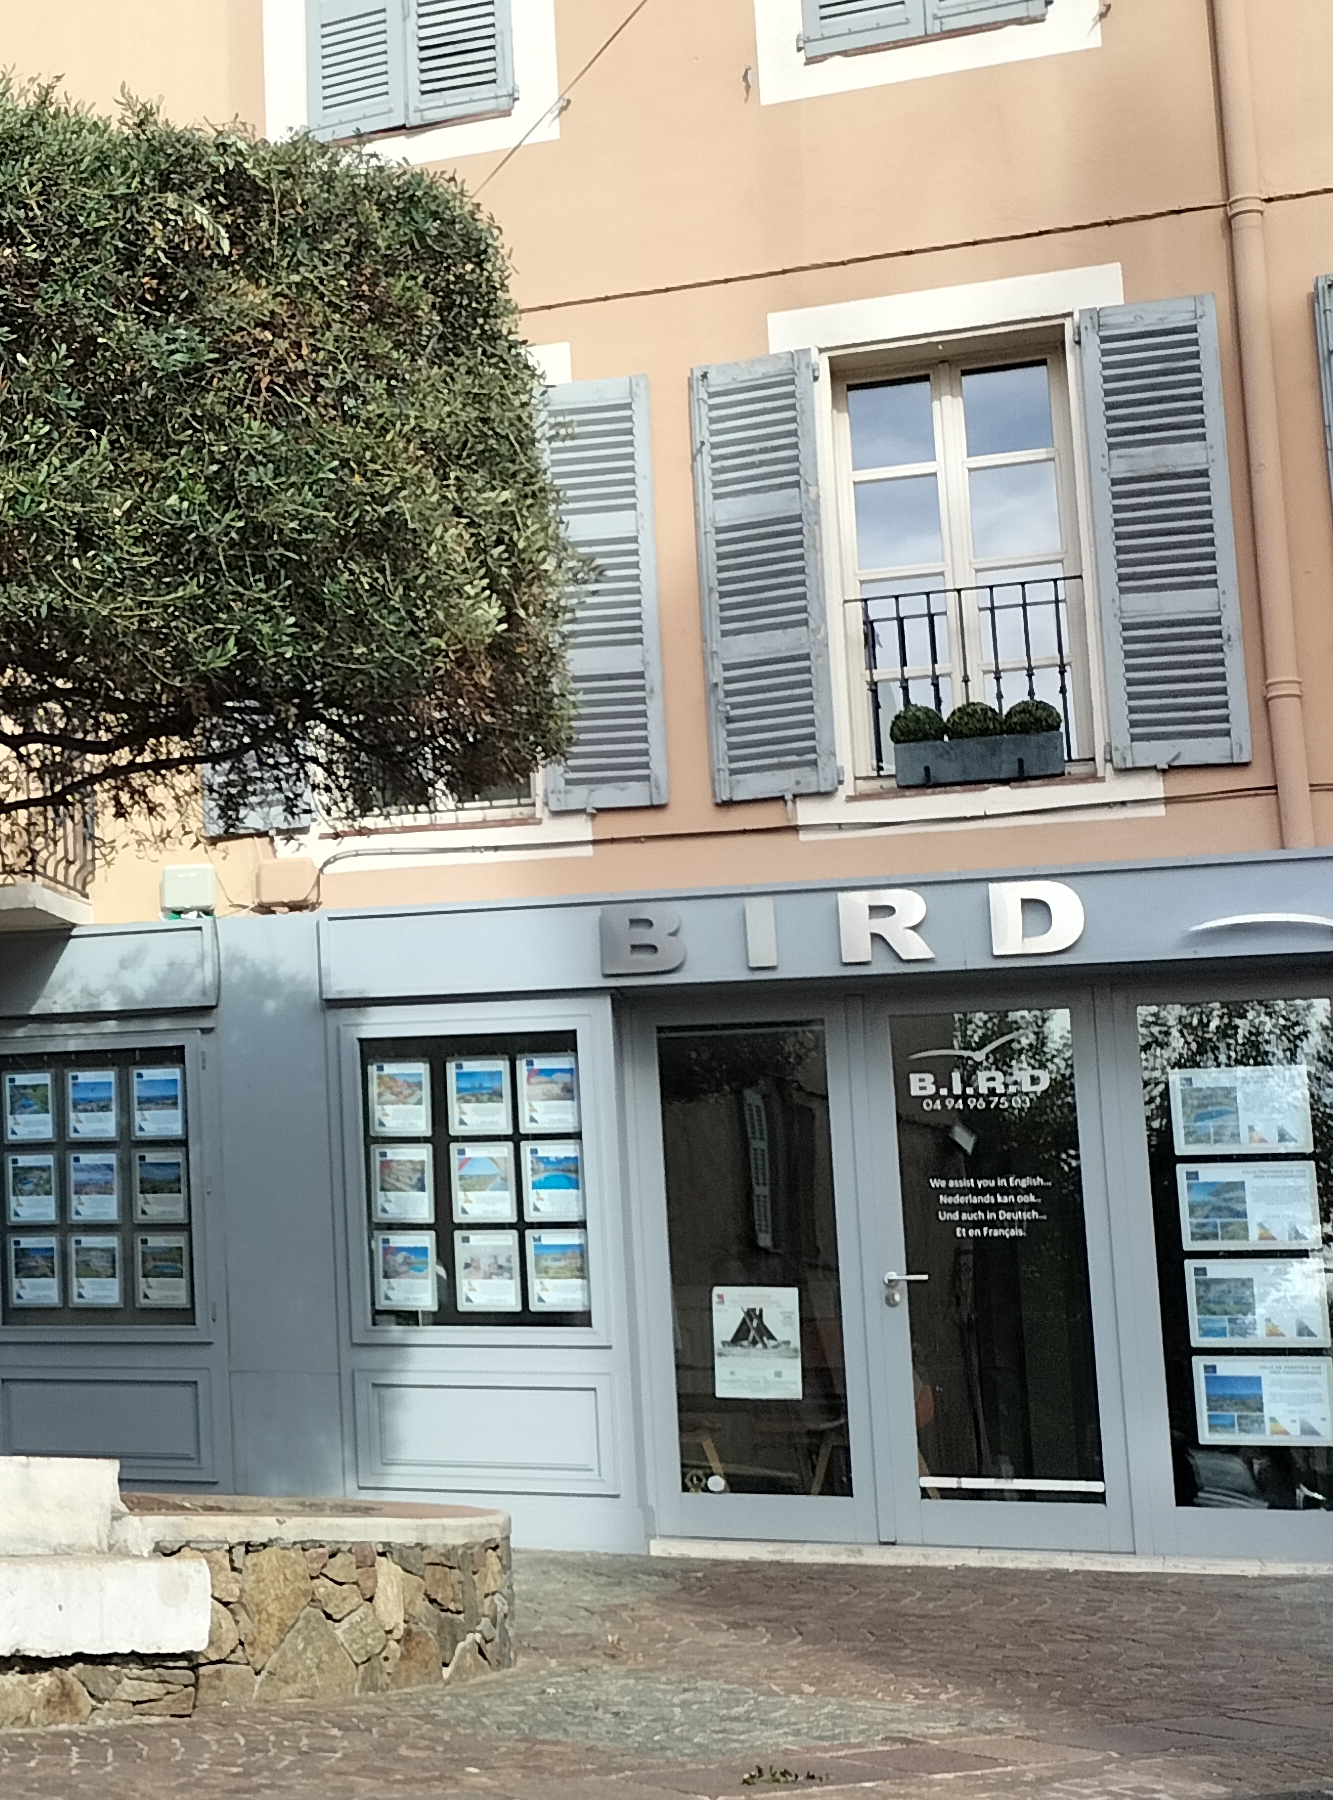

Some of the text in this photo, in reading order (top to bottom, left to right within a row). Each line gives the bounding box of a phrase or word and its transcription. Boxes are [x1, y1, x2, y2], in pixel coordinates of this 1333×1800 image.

[909, 1068, 1051, 1096] B.I.R.D
[922, 1096, 1031, 1111] 04 94 96 75 03
[929, 1178, 946, 1188] We
[948, 1178, 975, 1188] assist
[977, 1178, 995, 1189] you
[997, 1177, 1007, 1187] in
[939, 1194, 995, 1205] Nederlands
[996, 1193, 1014, 1203] kan
[938, 1210, 959, 1221] Und
[961, 1210, 984, 1220] auch
[986, 1210, 996, 1220] in
[956, 1227, 966, 1238] Et
[968, 1228, 981, 1237] en
